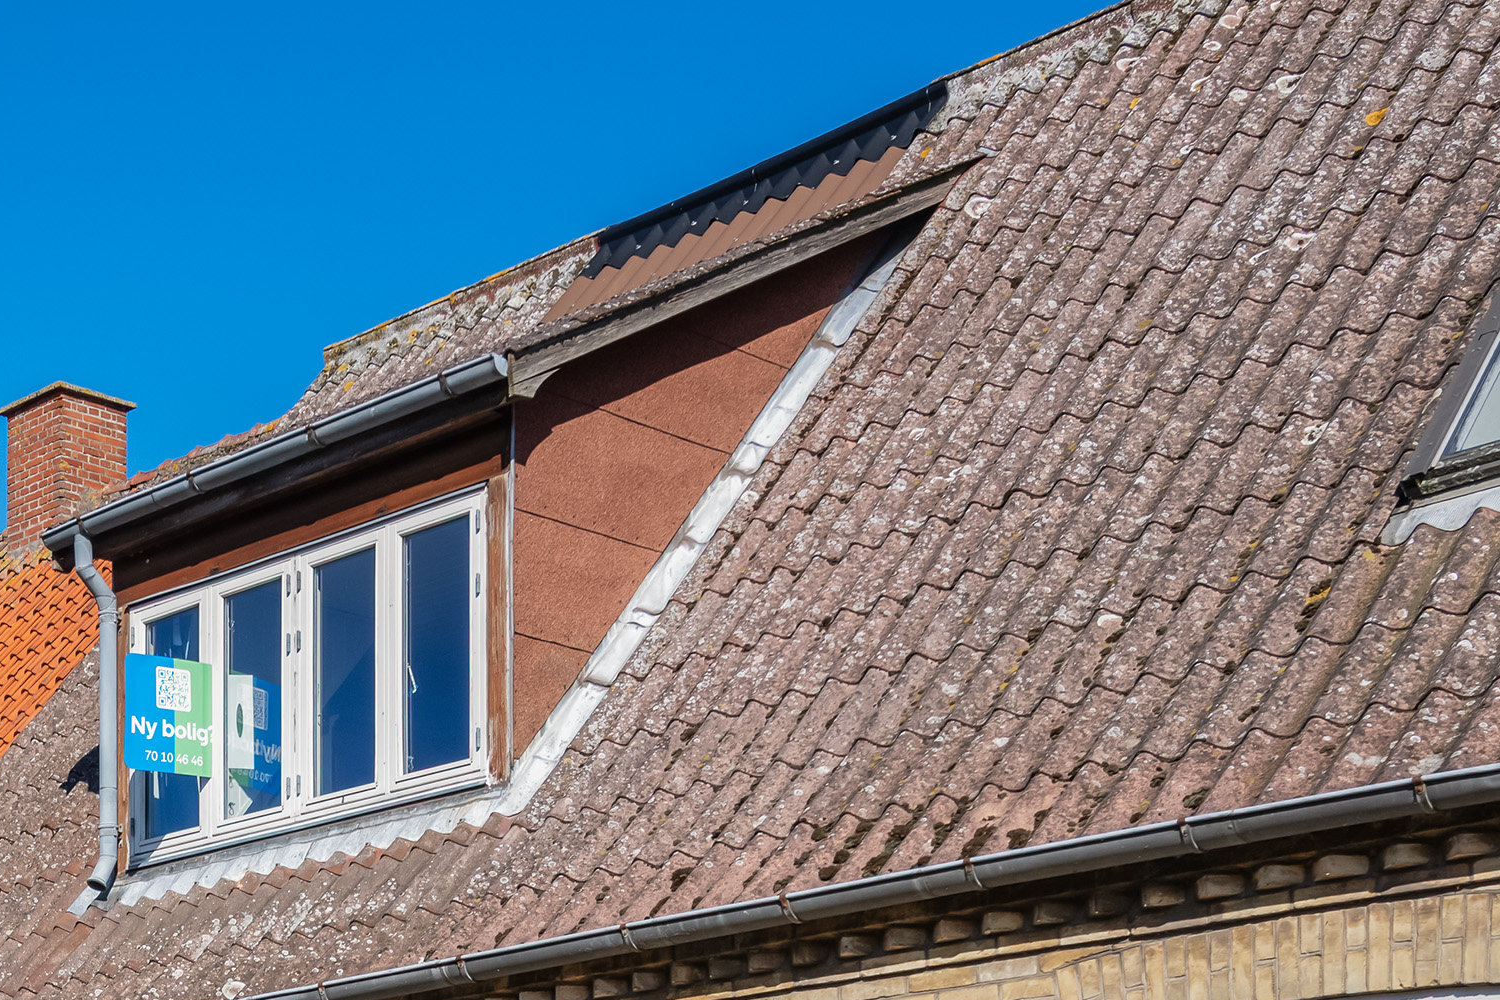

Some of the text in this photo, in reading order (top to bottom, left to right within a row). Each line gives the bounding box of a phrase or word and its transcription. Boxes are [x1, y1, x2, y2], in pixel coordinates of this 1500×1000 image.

[131, 715, 157, 739] Ny
[145, 750, 204, 767] 70 10 46 46
